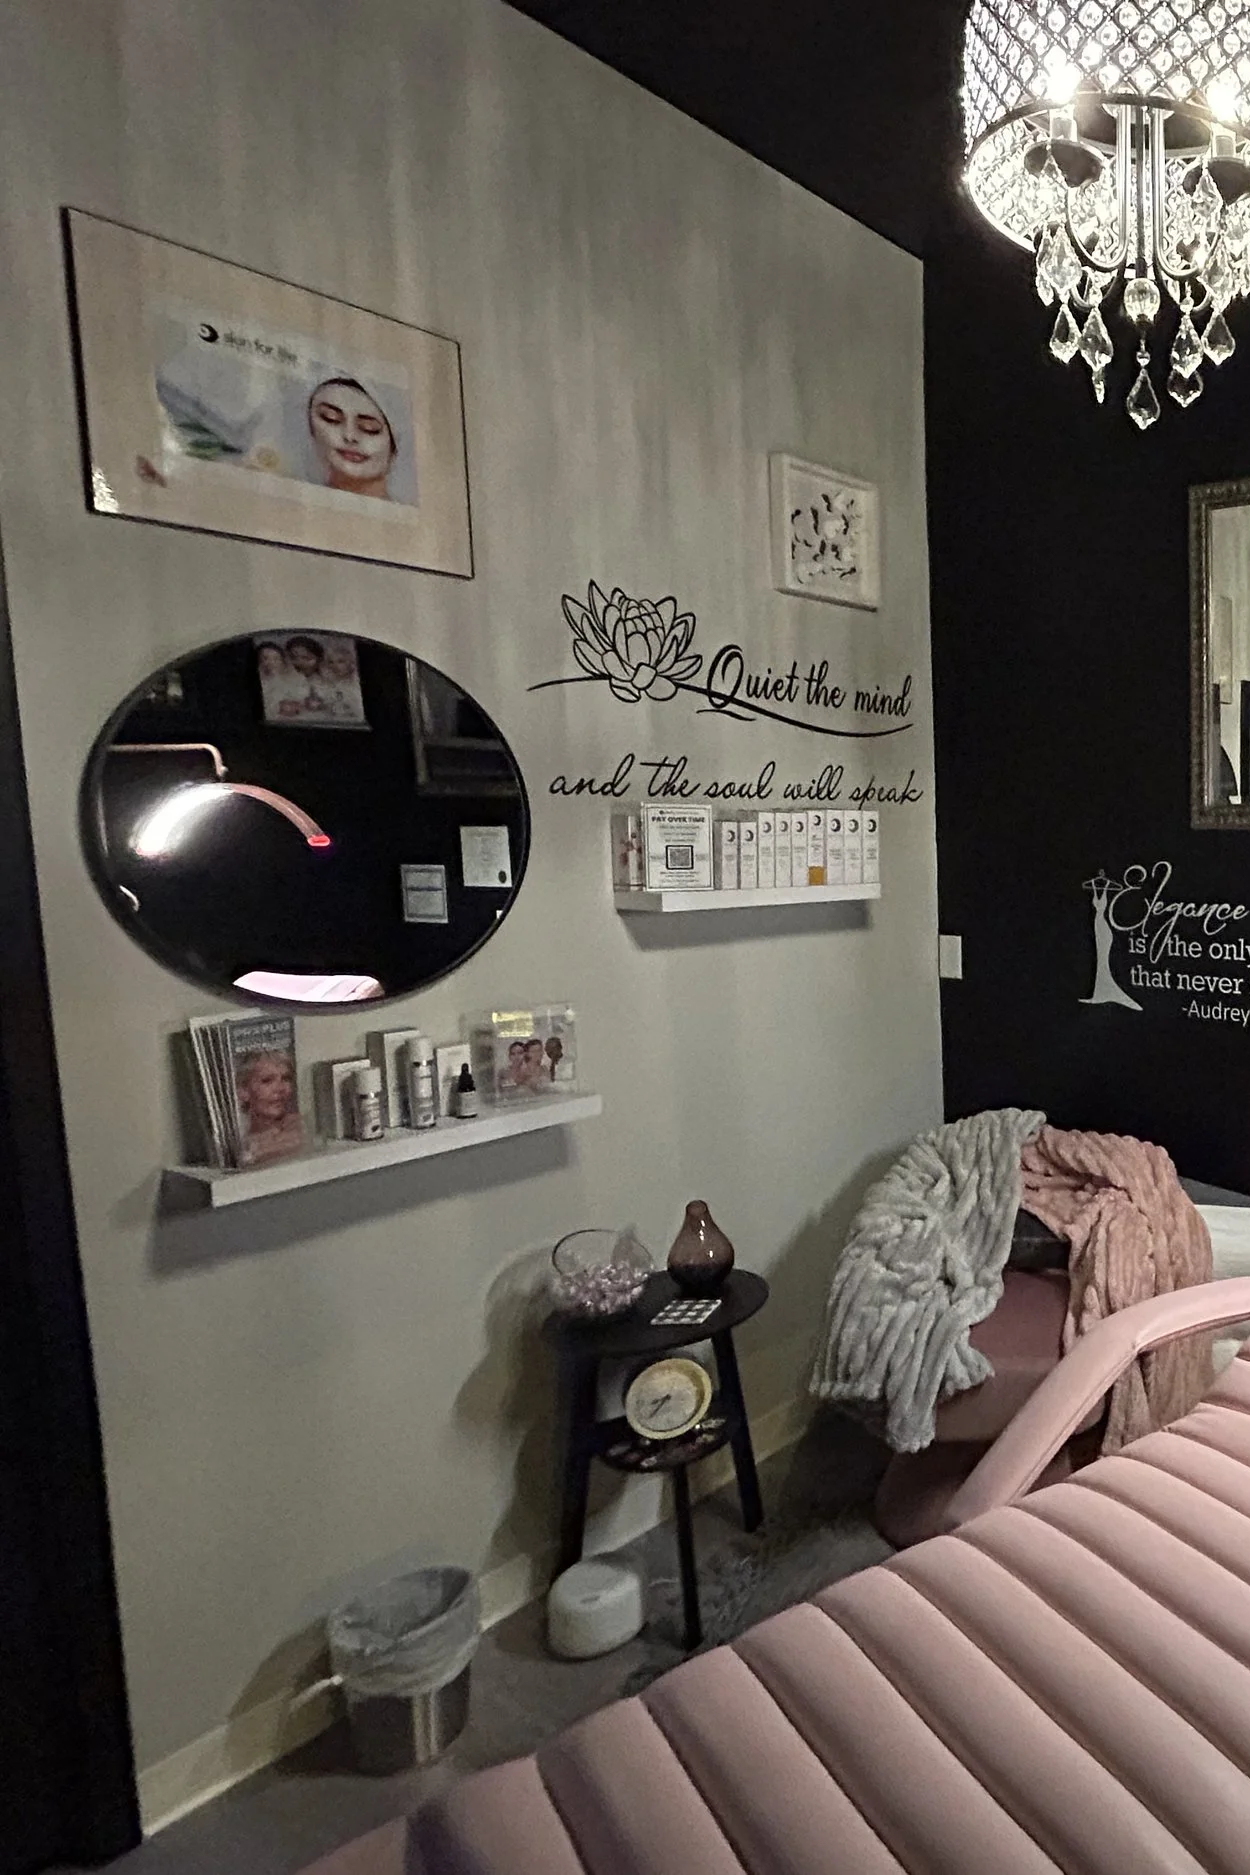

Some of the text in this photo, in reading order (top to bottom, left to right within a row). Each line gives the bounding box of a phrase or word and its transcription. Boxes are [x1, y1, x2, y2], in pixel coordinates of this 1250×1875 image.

[707, 644, 912, 717] Quiet the mind
[549, 753, 924, 811] and the soul will speak
[1109, 861, 1249, 963] Elegance
[1128, 932, 1146, 954] is
[1167, 935, 1202, 958] the
[1130, 965, 1171, 989] that
[1177, 974, 1243, 995] never
[1182, 1002, 1250, 1027] -Audrey
